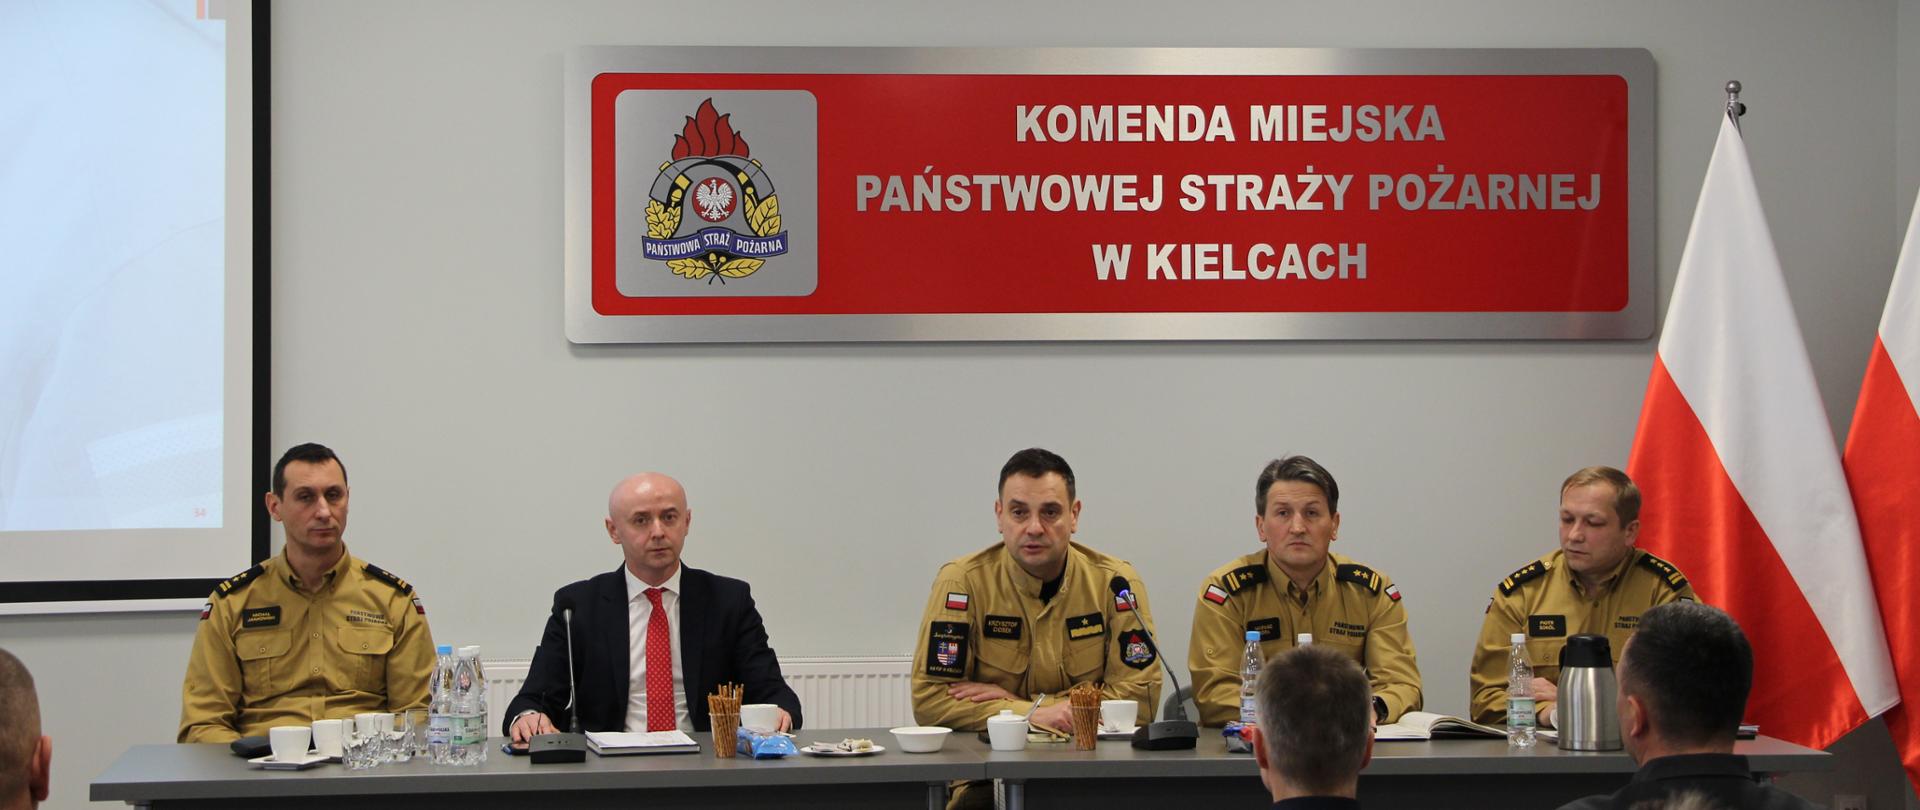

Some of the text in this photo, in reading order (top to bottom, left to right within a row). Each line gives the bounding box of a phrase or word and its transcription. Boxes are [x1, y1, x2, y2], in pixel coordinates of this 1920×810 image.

[1016, 104, 1446, 143] KOMENDA MIEJSKA
[856, 164, 1602, 212] PAŃSTWOWEJ STRAŻY POŻARNEJ
[646, 232, 783, 256] PAŃSTWOWA STRAŻ POŻARNA
[1092, 243, 1367, 281] W KIELCACH
